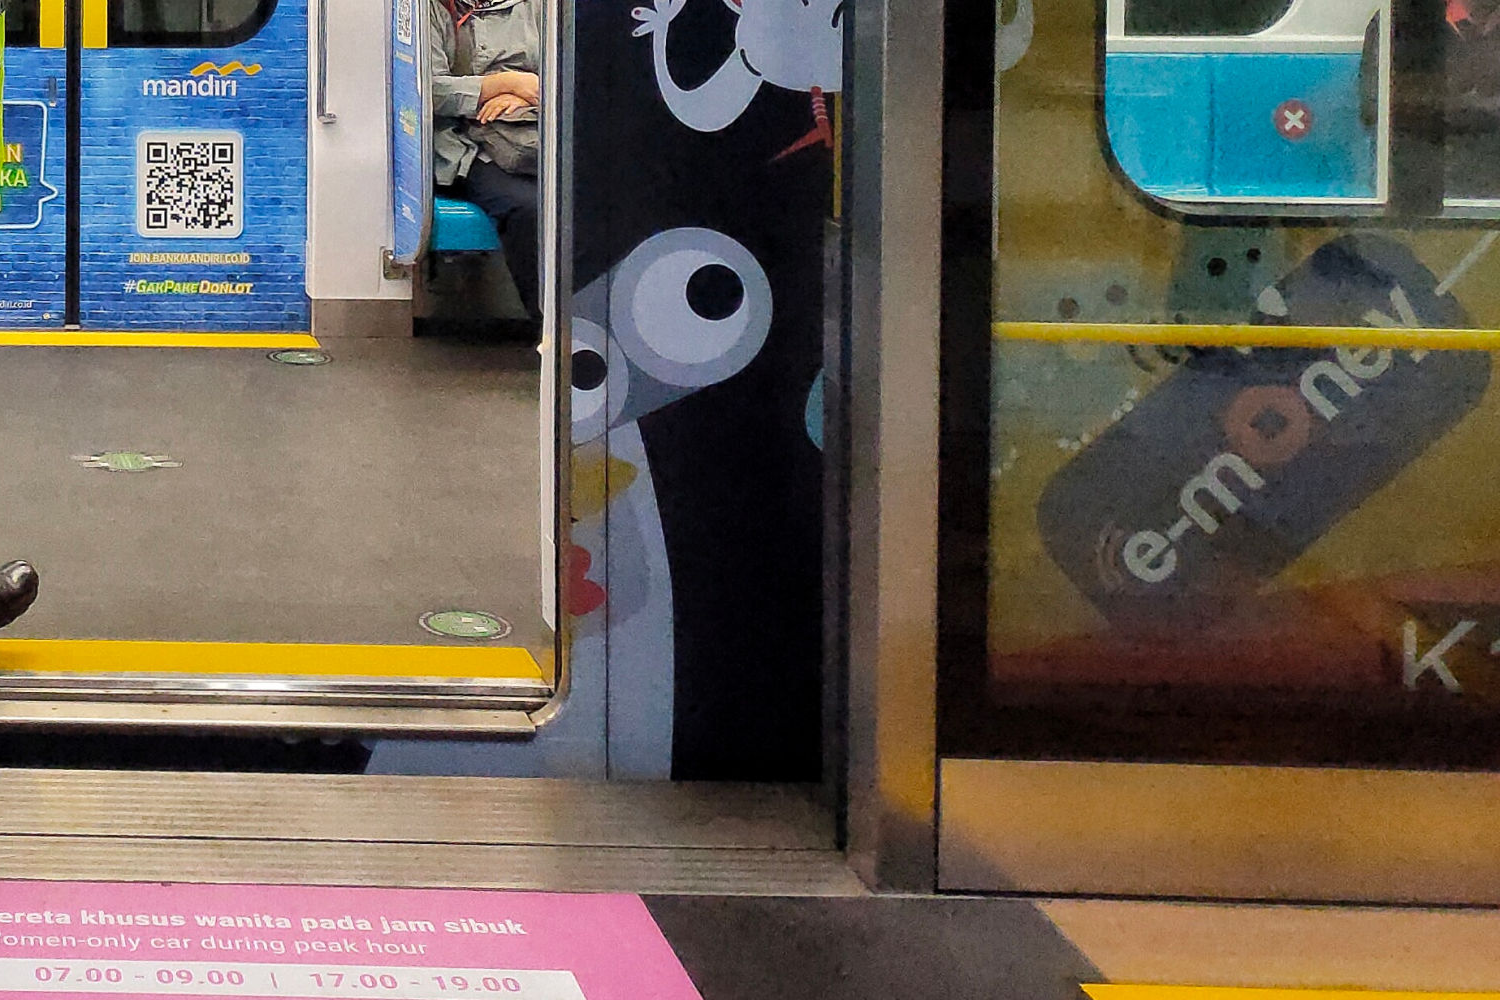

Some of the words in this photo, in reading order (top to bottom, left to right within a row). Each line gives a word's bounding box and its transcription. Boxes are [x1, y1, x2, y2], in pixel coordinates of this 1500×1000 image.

[142, 73, 237, 97] mandiri
[5, 144, 22, 163] N
[0, 168, 28, 187] KA
[81, 909, 186, 927] khusus
[195, 913, 292, 929] wanita
[300, 915, 373, 933] pada
[381, 916, 436, 935] jam
[444, 918, 527, 935] sibuk
[150, 935, 191, 950] car
[201, 934, 286, 955] during
[295, 938, 359, 957] peak
[366, 939, 428, 955] hour
[35, 966, 123, 984] 07.00
[156, 968, 245, 986] 09.00
[310, 972, 398, 990] 17.00
[432, 974, 521, 993] 19.00
